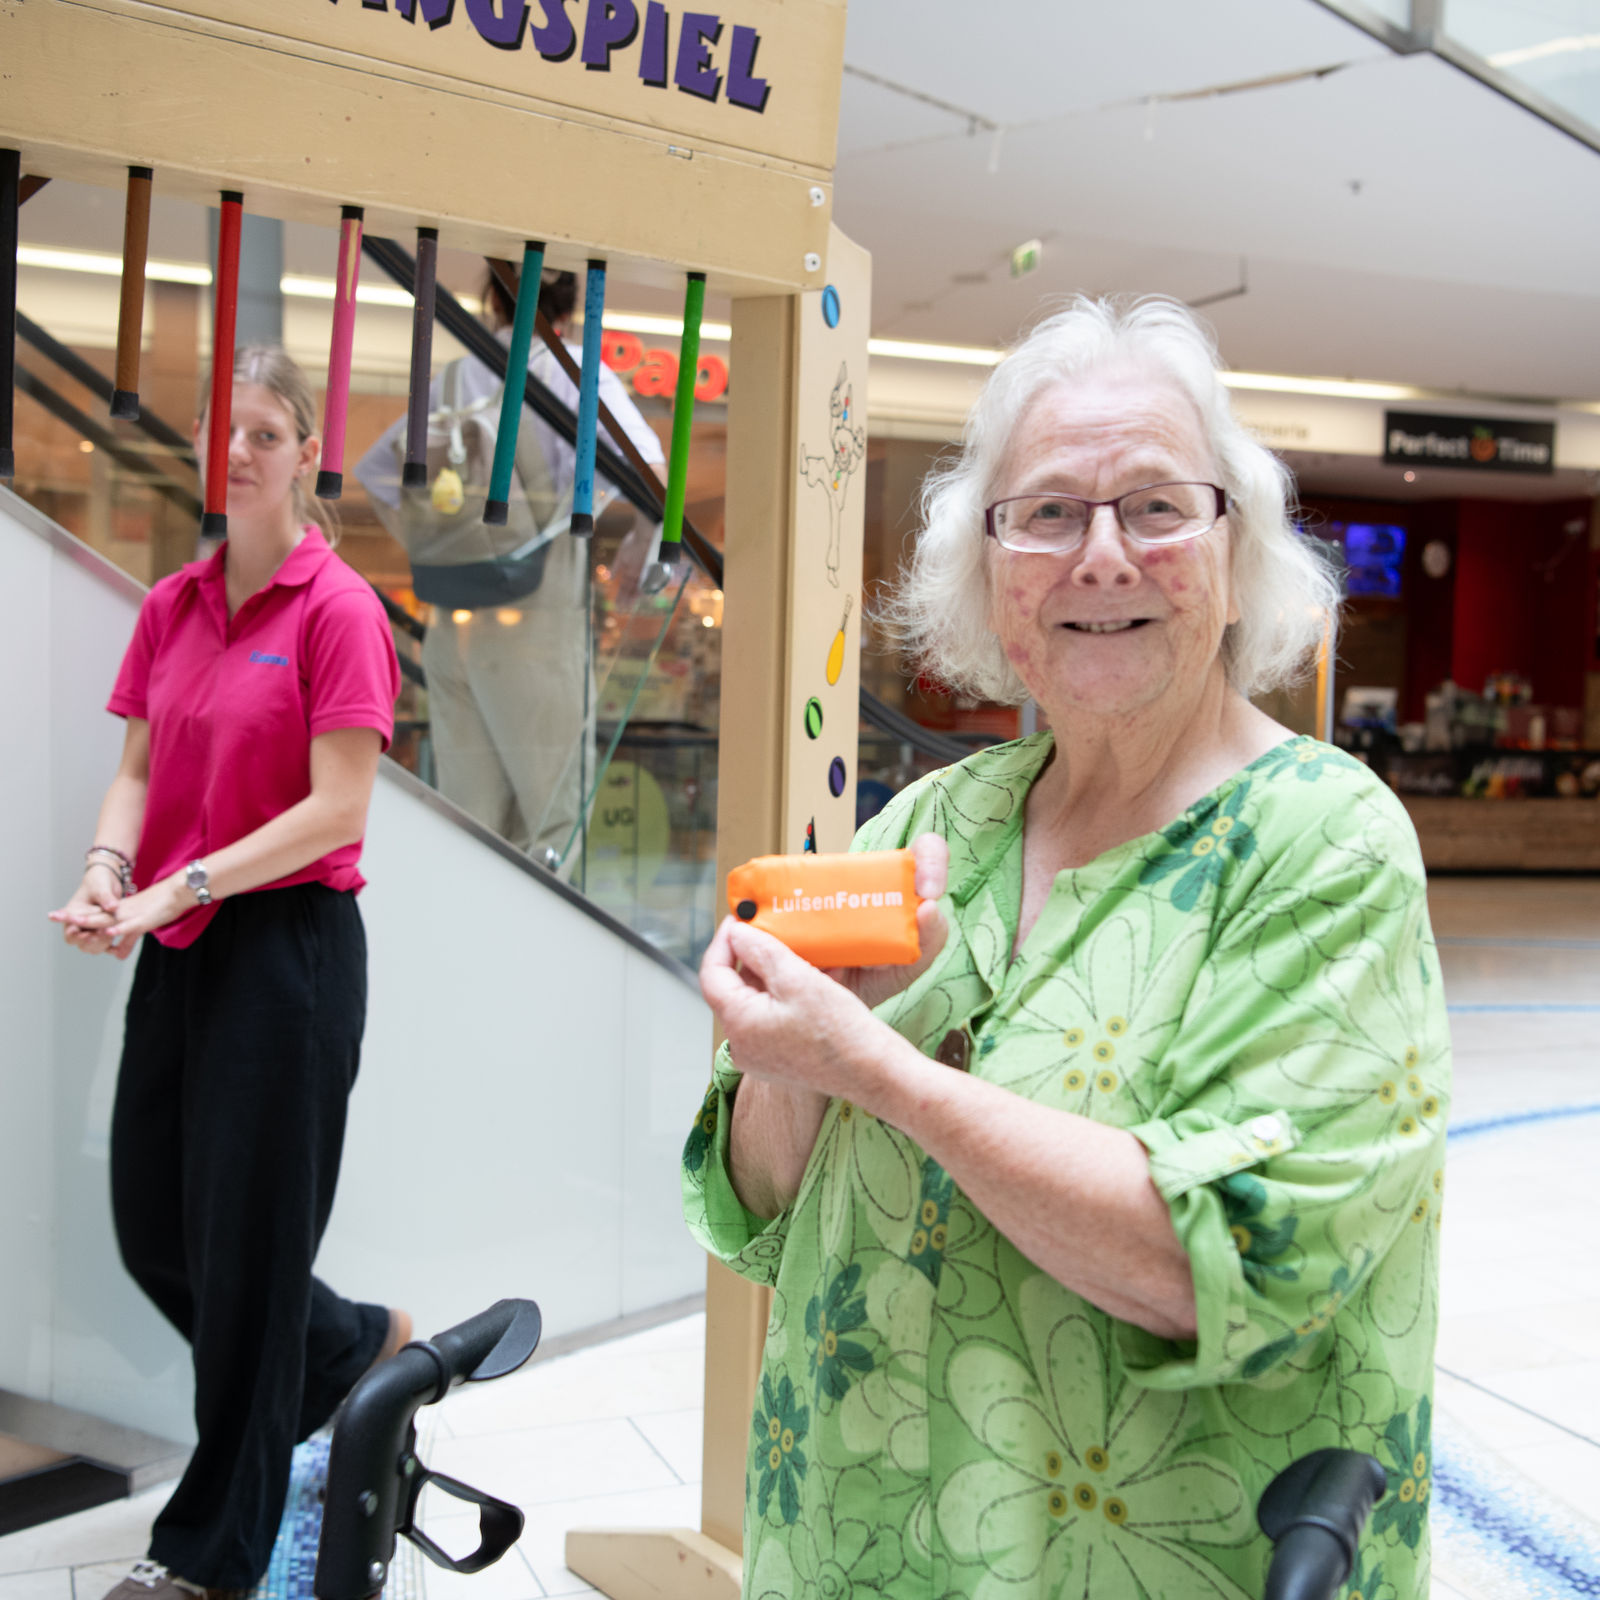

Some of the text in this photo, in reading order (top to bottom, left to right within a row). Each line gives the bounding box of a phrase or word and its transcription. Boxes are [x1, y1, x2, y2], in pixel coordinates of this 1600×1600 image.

[1388, 429, 1549, 464] Perfect Time
[772, 888, 903, 913] LuisenForum
